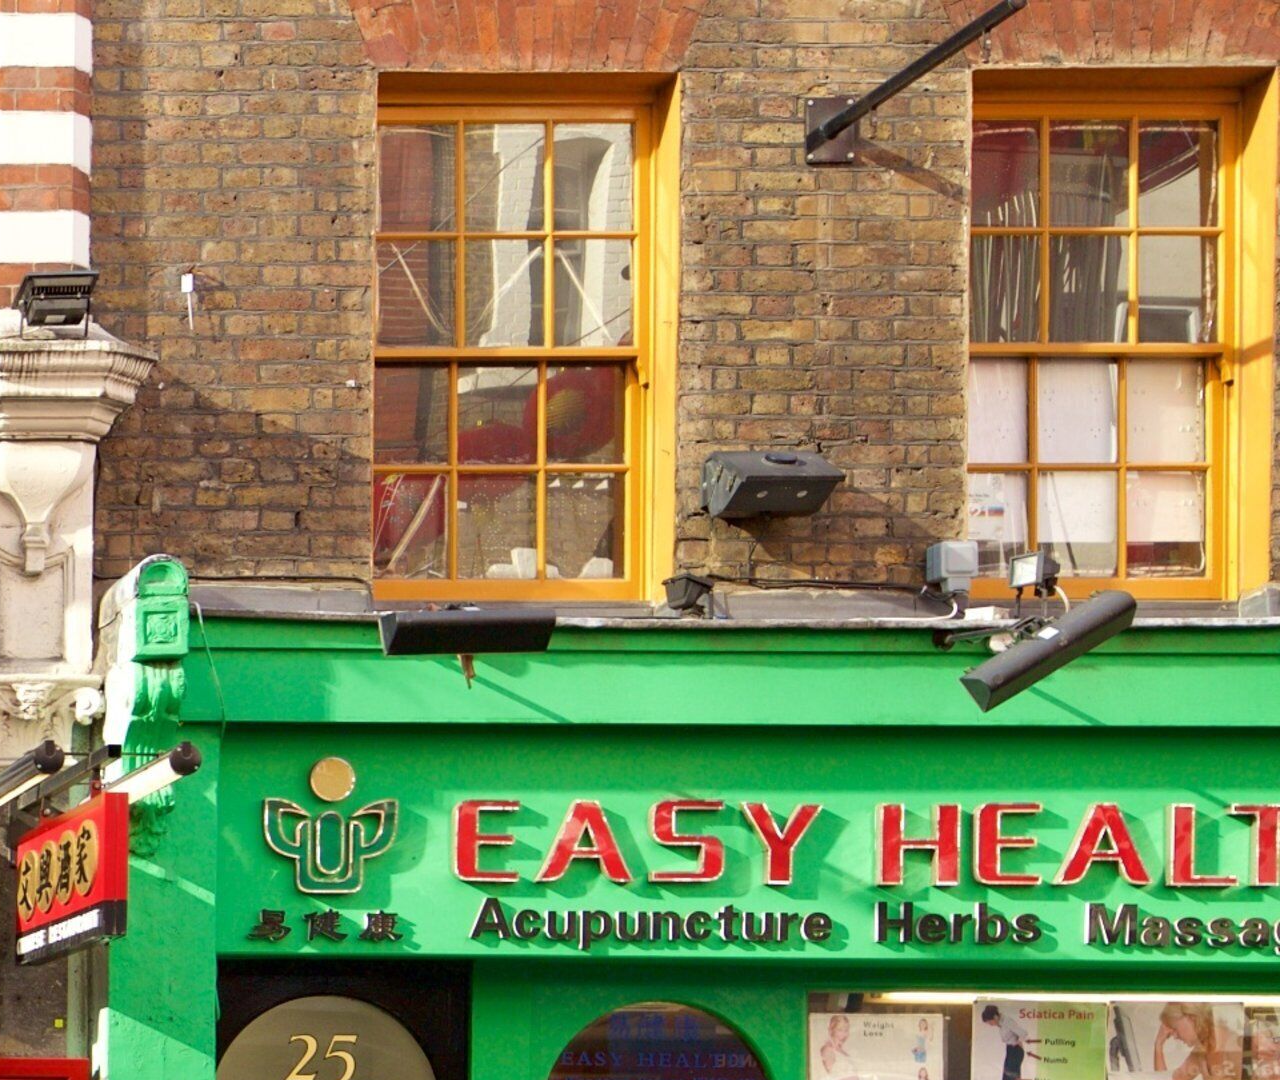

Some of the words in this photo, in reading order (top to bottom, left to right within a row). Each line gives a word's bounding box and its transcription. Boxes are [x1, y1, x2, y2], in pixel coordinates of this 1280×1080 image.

[450, 798, 823, 887] EASY
[18, 824, 95, 914] 文興酒家
[246, 908, 404, 943] 易健康
[469, 896, 833, 951] Acupuncture
[872, 901, 1043, 944] Herbs
[1018, 1007, 1065, 1021] Sciatica
[1067, 1008, 1095, 1021] Pain
[559, 1051, 624, 1068] EASY
[1042, 1055, 1069, 1065] Numb
